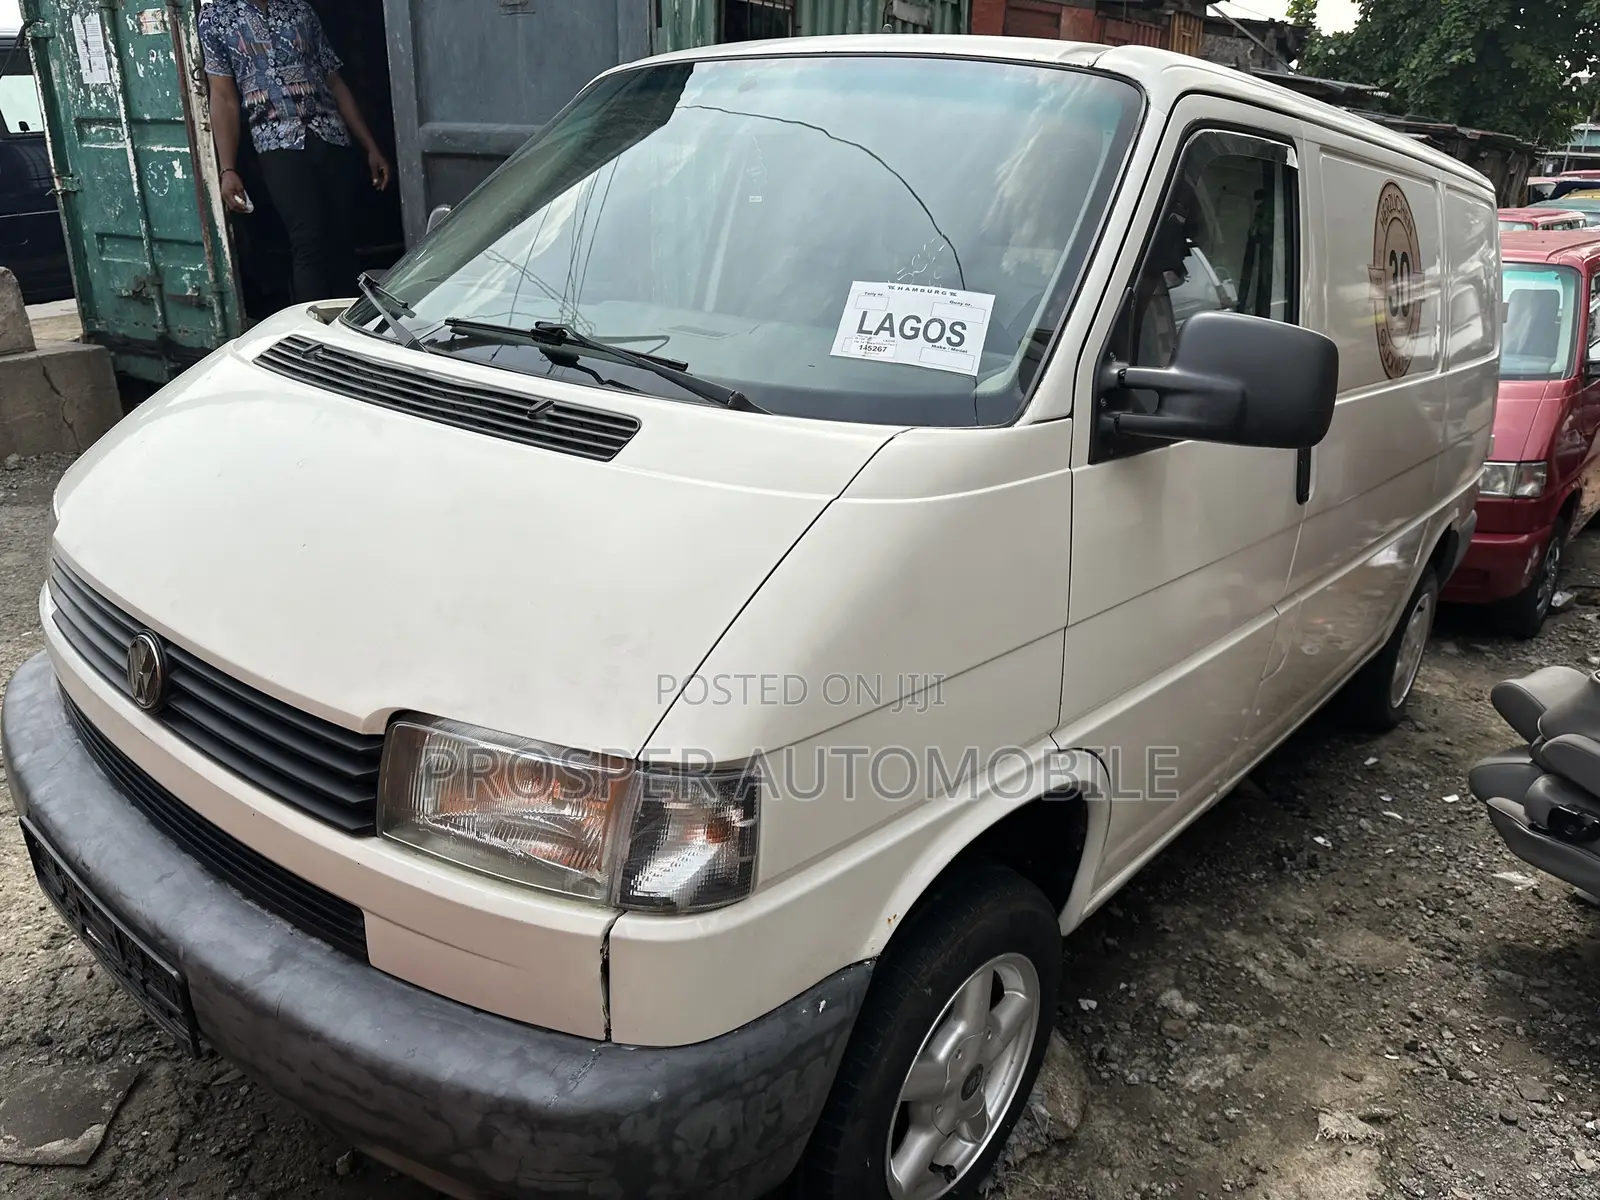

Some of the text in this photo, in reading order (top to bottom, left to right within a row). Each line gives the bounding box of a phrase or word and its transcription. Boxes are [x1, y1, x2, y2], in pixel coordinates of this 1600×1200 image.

[897, 285, 947, 296] HAMBURG
[1389, 250, 1410, 317] 30
[856, 310, 967, 348] LAGOS
[859, 344, 888, 353] 145267
